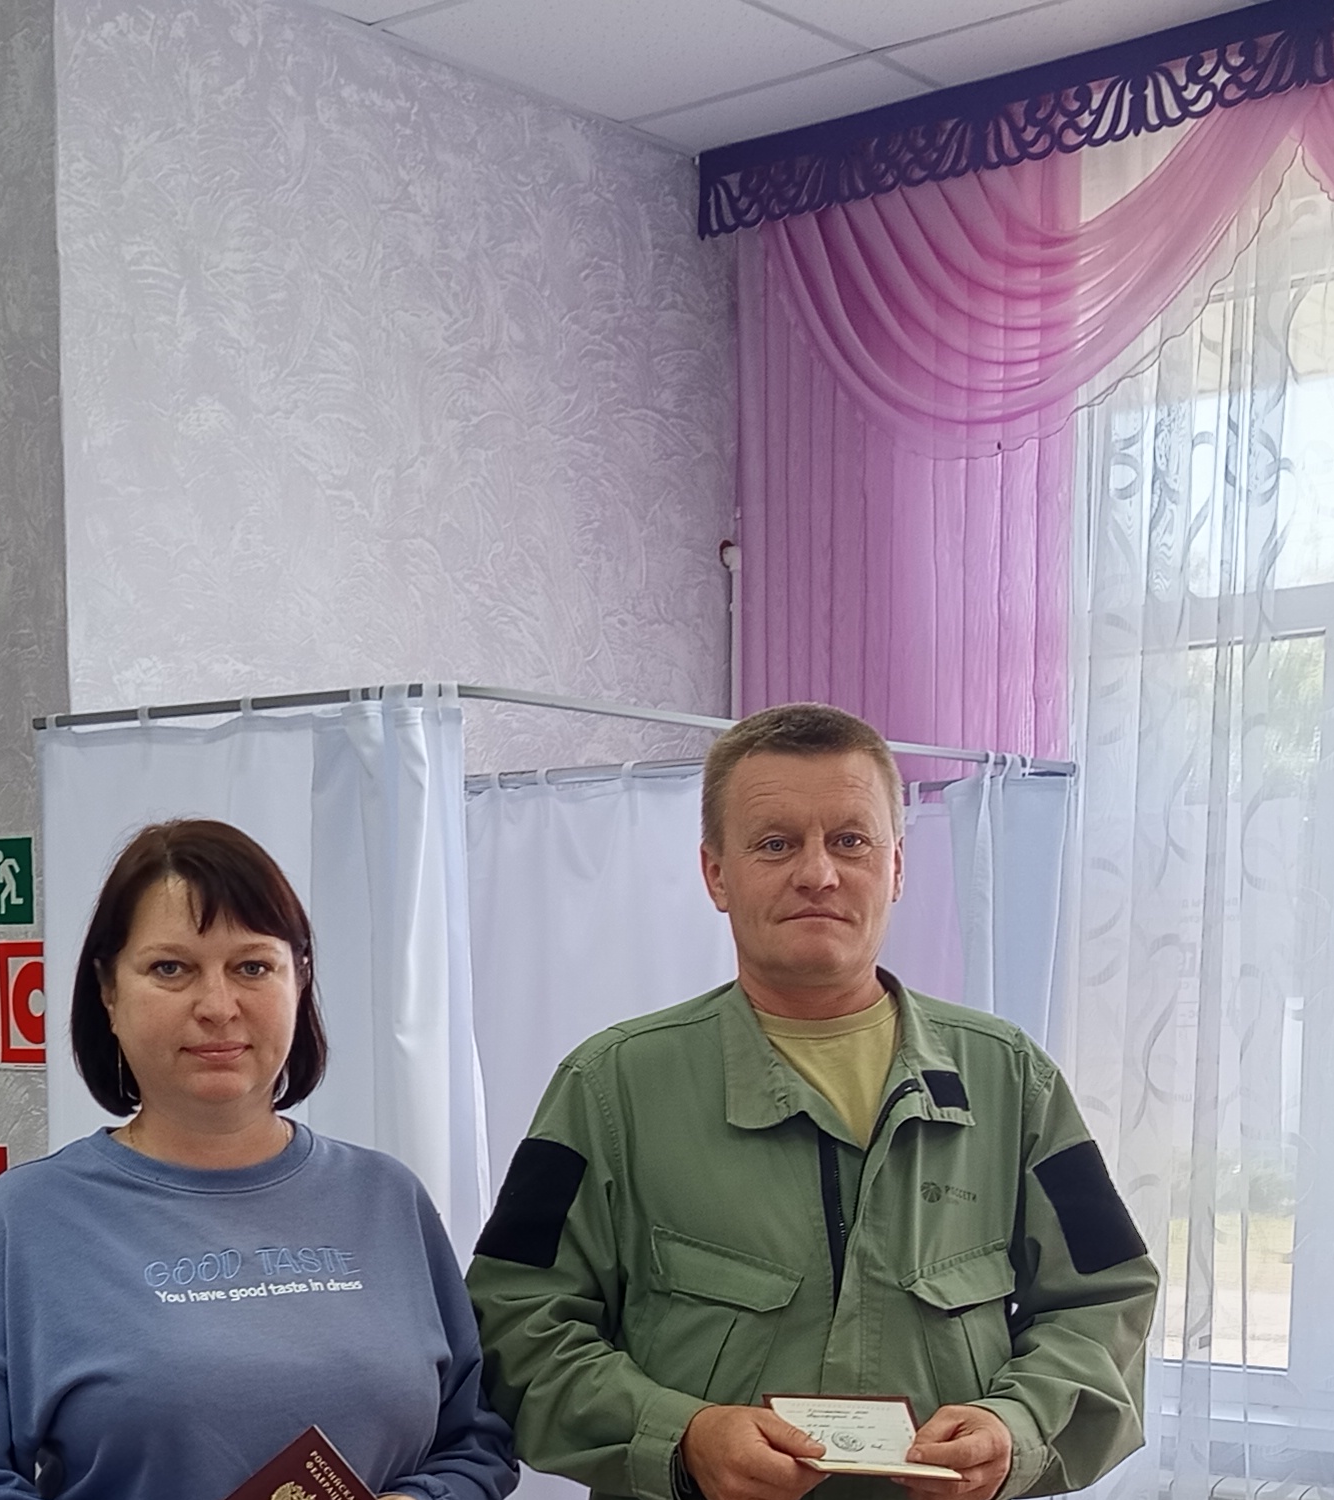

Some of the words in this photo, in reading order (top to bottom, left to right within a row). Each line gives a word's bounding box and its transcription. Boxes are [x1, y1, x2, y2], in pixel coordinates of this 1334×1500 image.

[144, 1249, 242, 1287] GOOD
[255, 1247, 361, 1276] TASTE
[155, 1289, 186, 1303] You
[188, 1289, 226, 1302] have
[229, 1283, 267, 1301] good
[268, 1281, 308, 1295] taste
[309, 1279, 325, 1292] in
[327, 1279, 363, 1291] dress
